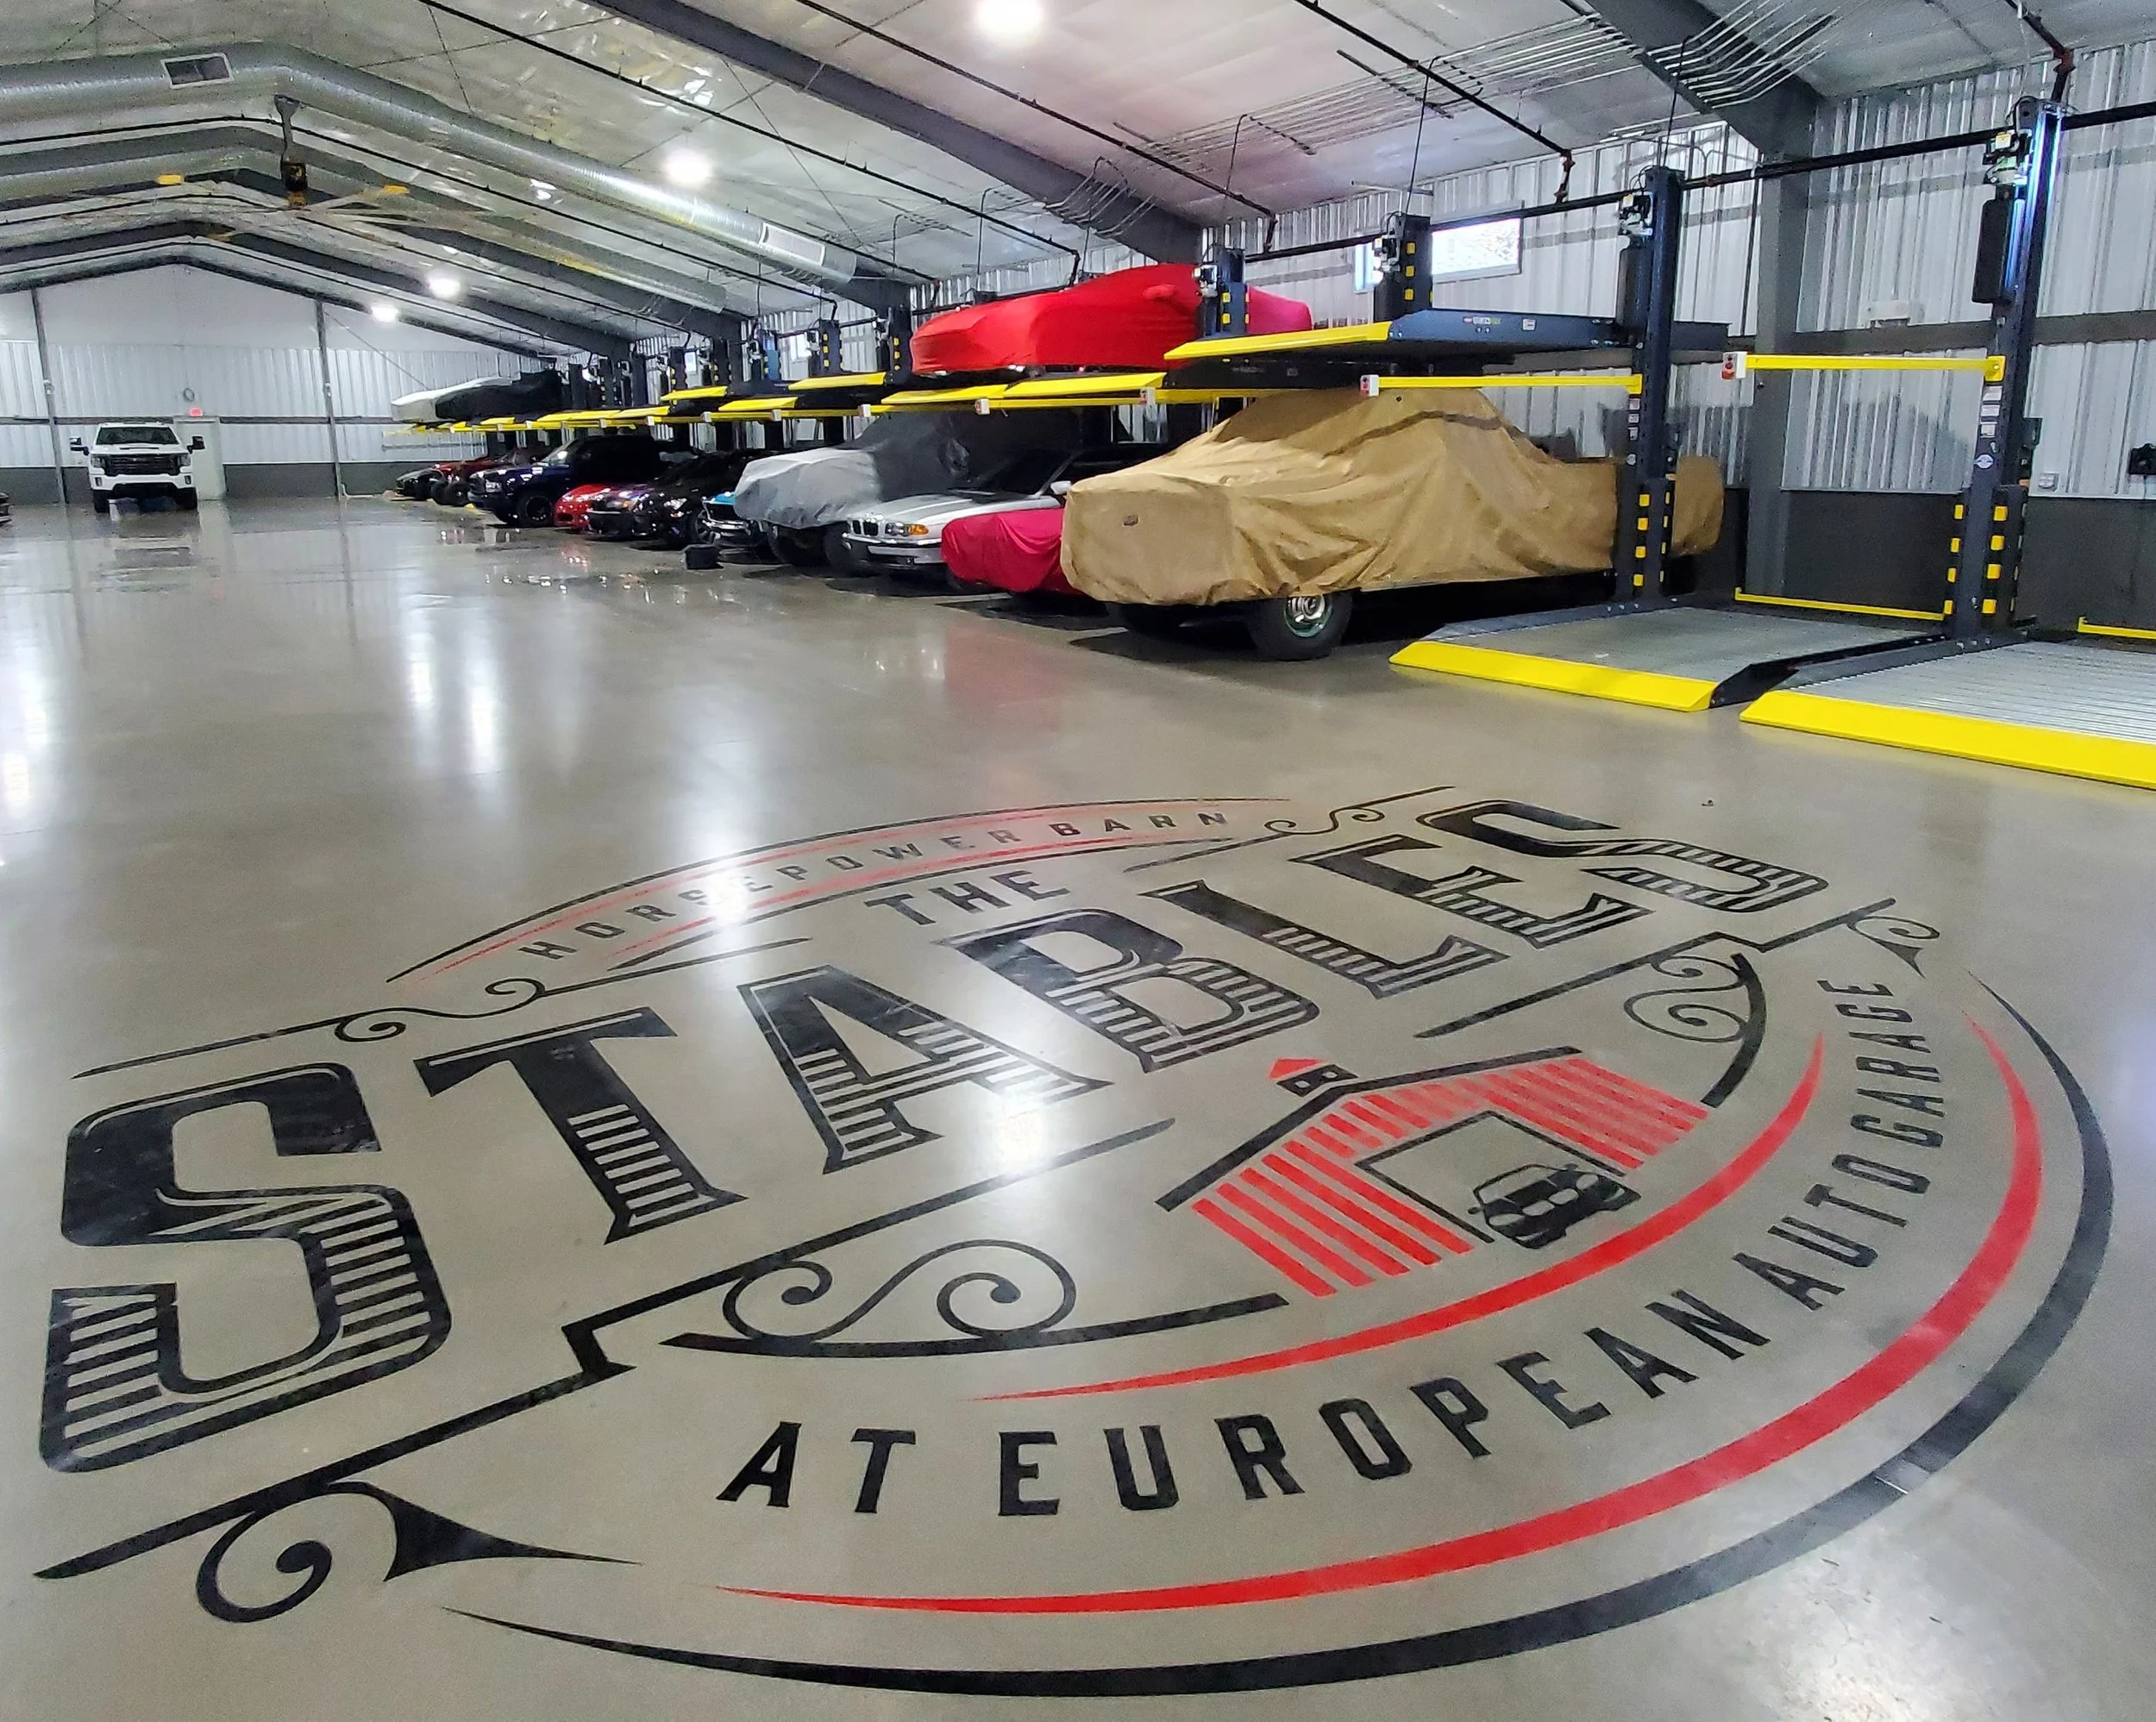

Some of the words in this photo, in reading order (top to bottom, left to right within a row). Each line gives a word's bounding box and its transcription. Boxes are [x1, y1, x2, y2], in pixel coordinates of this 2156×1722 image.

[1049, 813, 1228, 836] BARN
[863, 870, 1069, 926] THE
[39, 798, 1829, 1473] STABLES
[716, 1421, 916, 1514] AT
[998, 1289, 1771, 1516] EUROPEAN
